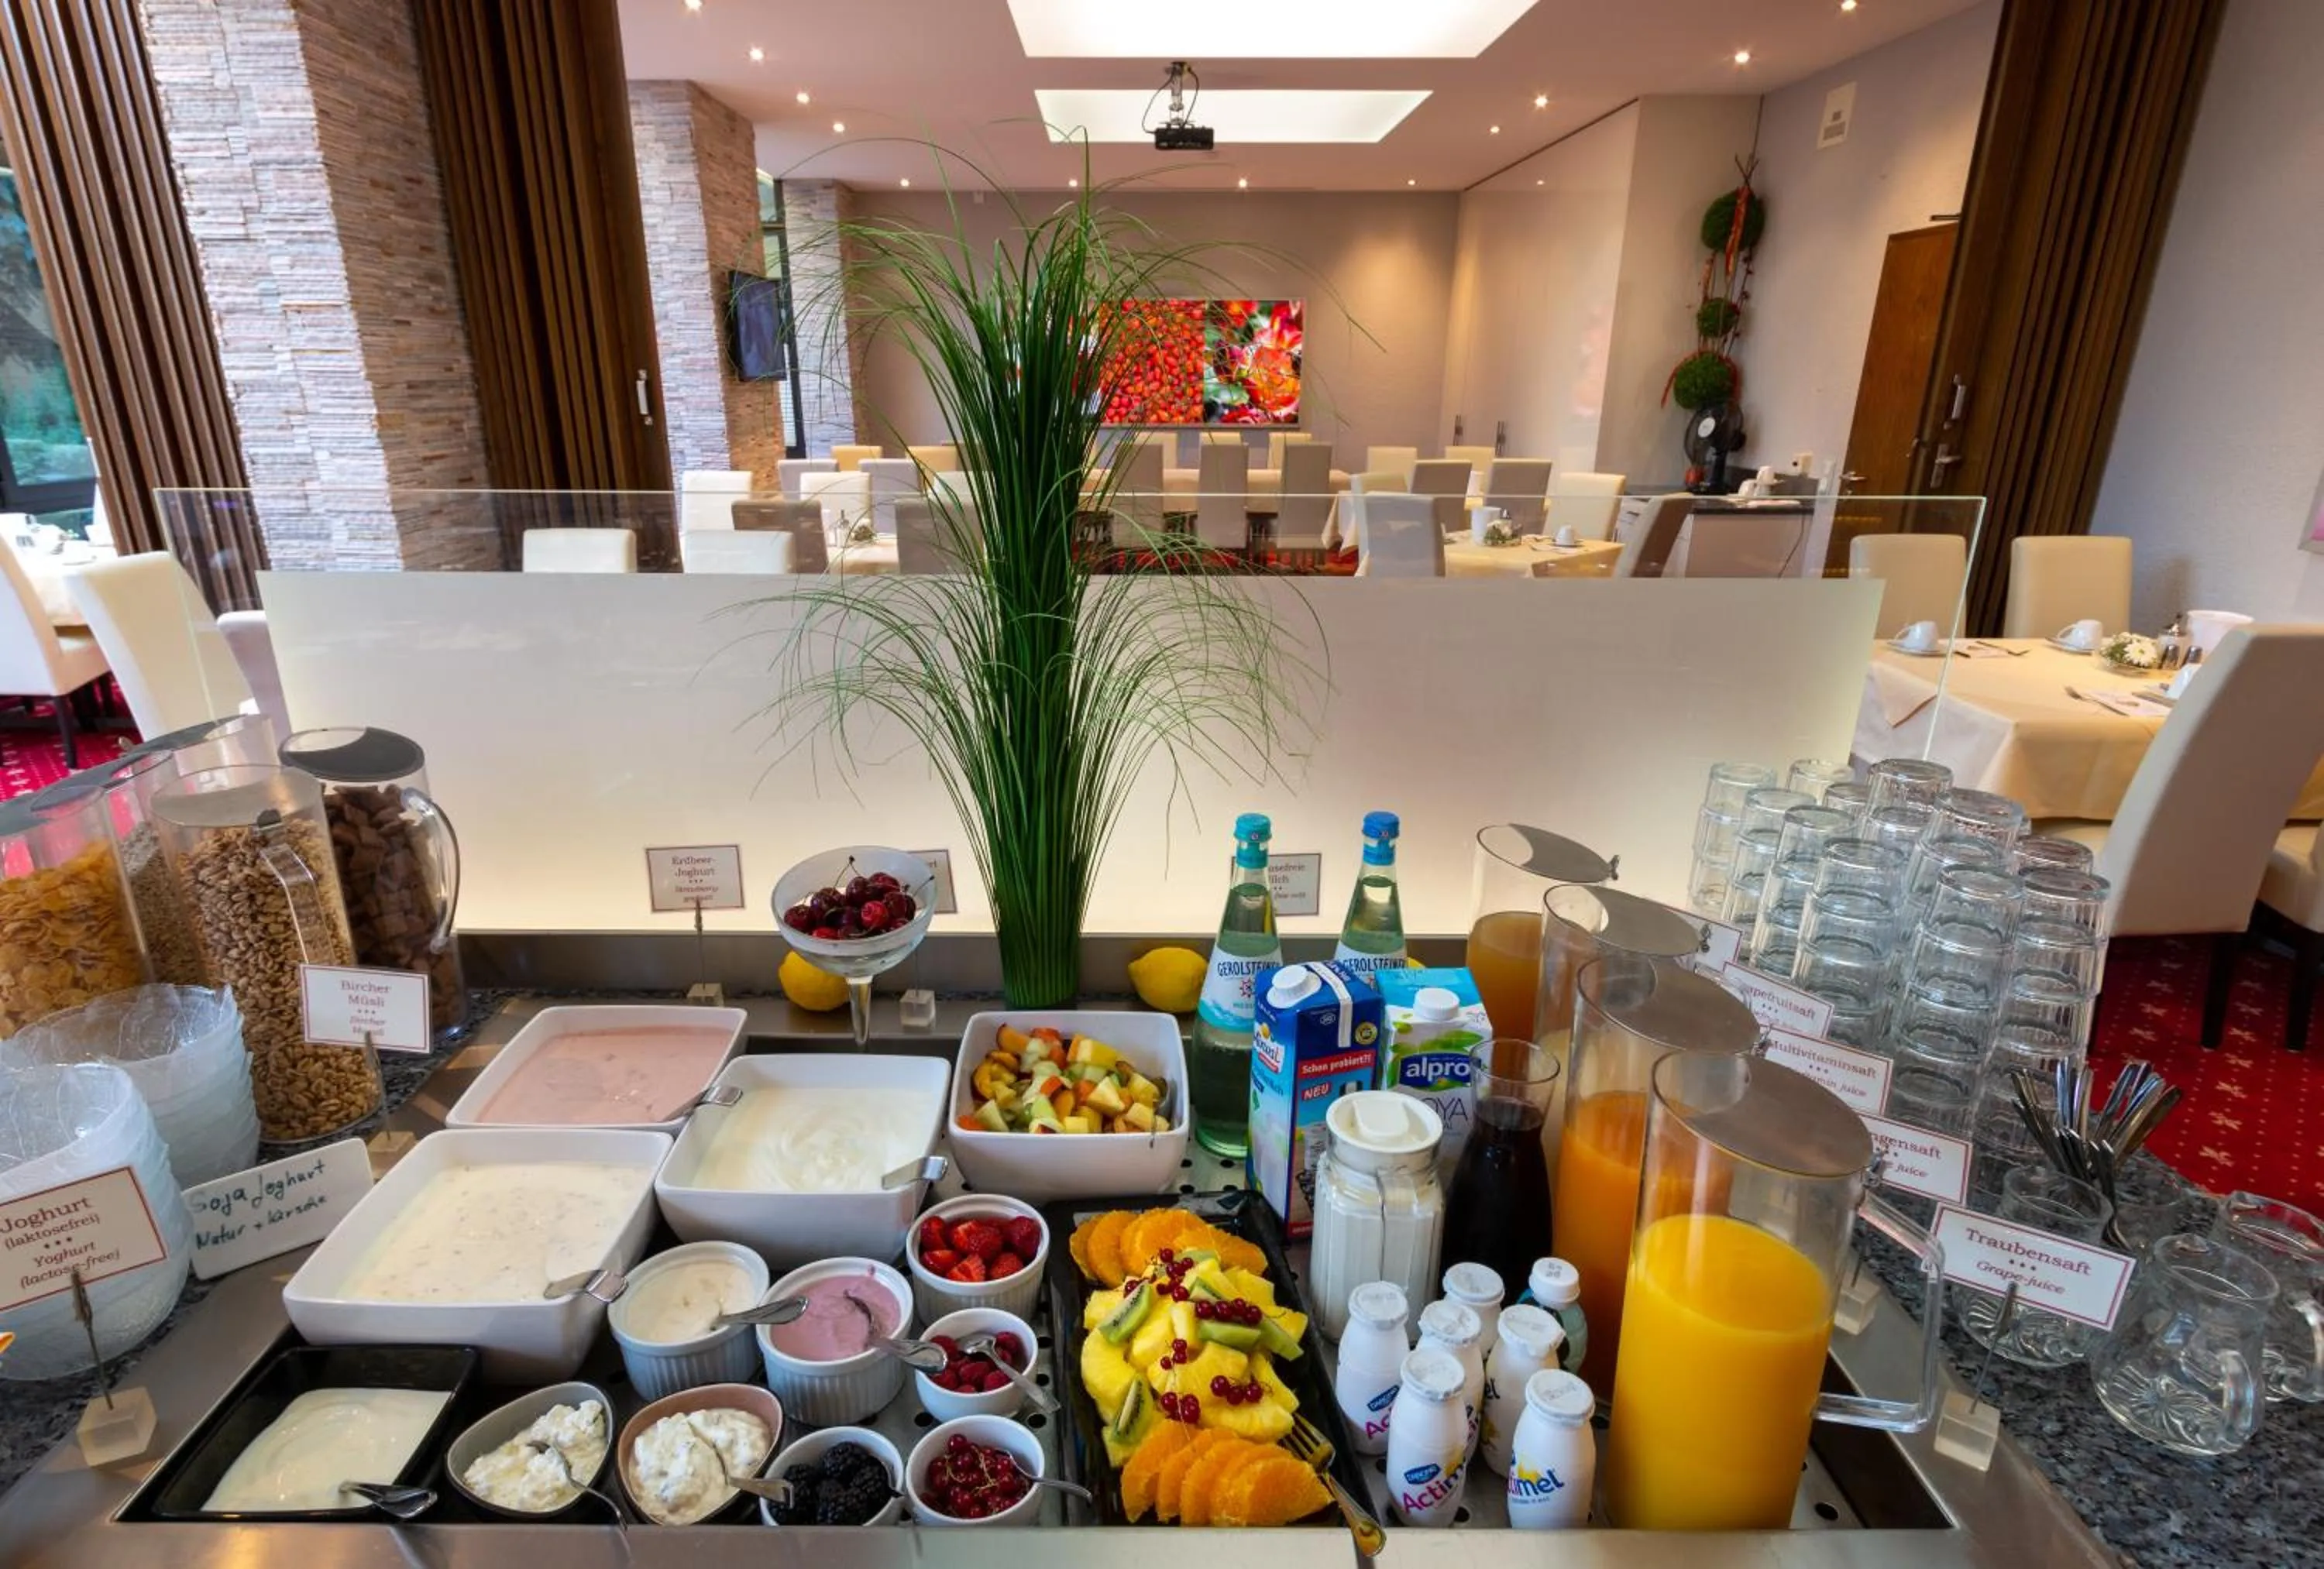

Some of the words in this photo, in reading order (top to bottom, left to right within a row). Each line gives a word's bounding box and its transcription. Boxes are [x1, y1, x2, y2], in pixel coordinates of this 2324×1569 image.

[674, 867, 715, 878] Joghurt
[341, 980, 392, 994] Bircher
[349, 995, 385, 1007] Müsli
[1301, 1062, 1329, 1075] Schon
[1406, 1058, 1470, 1082] alpro
[1304, 1083, 1329, 1100] NEU
[251, 1159, 325, 1210] Joghurt
[0, 1197, 94, 1234] Joghurt
[4, 1214, 100, 1251] (laktosefrei)
[195, 1223, 246, 1250] Natur
[33, 1241, 96, 1268] Yoghurt
[1966, 1227, 2092, 1276] Traubensaft
[20, 1248, 121, 1289] (lactose-free)
